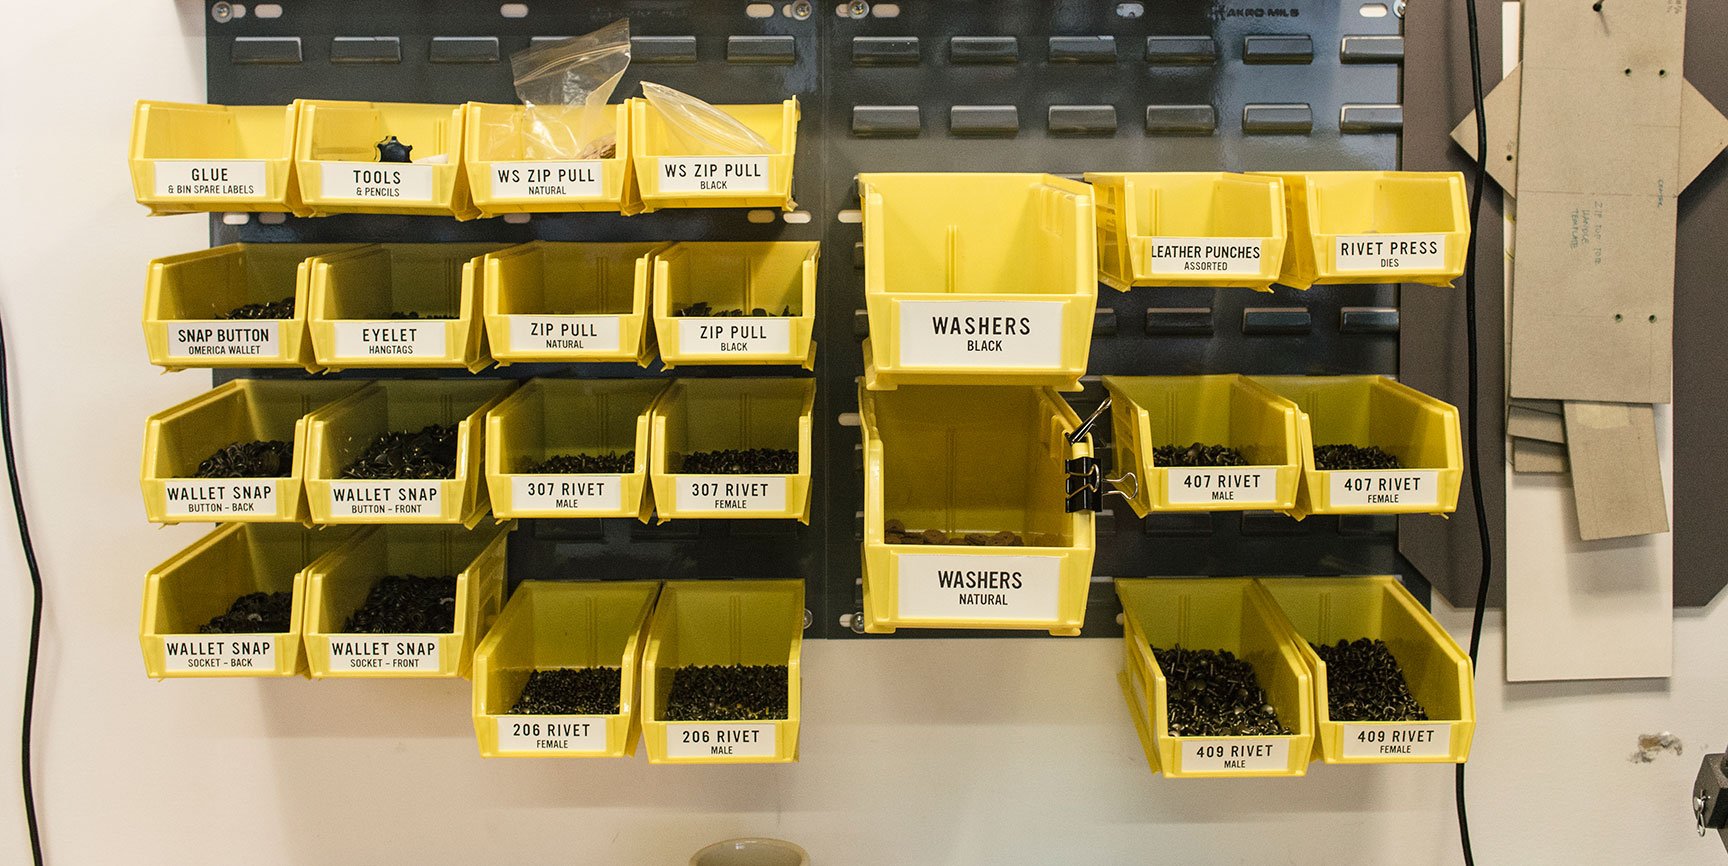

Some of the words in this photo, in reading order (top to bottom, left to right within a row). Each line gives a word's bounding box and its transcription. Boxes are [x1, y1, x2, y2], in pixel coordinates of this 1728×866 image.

[1227, 8, 1264, 17] AKRO
[191, 168, 228, 182] GLUE
[498, 170, 520, 183] WS
[528, 170, 551, 183] ZIP
[559, 169, 595, 182] PULL
[665, 164, 687, 177] WS
[694, 164, 718, 177] ZIP
[725, 164, 761, 177] PULL
[354, 170, 401, 185] TOOLS
[168, 186, 175, 194] &
[177, 185, 192, 194] BIN
[194, 185, 220, 194] SPARE
[223, 185, 254, 194] LABELS
[529, 186, 567, 195] NATURAL
[700, 181, 727, 190] BLACK
[356, 188, 363, 196] &
[365, 187, 400, 197] PENCILS
[1152, 245, 1201, 258] LEATHER
[1206, 246, 1260, 259] PUNCHES
[1341, 242, 1383, 256] RIVET
[1390, 241, 1438, 255] PRESS
[1184, 262, 1228, 271] ASSORTED
[1381, 258, 1399, 268] DIES
[531, 323, 554, 336] ZIP
[561, 323, 597, 337] PULL
[932, 317, 1030, 335] WASHERS
[178, 329, 213, 343] SNAP
[217, 329, 269, 342] BUTTON
[363, 329, 417, 342] EYELET
[700, 326, 723, 339] ZIP
[731, 325, 767, 339] PULL
[189, 346, 226, 355] OMERICA
[228, 345, 260, 354] WALLET
[369, 345, 413, 354] HANGTAGS
[546, 340, 584, 349] NATURAL
[721, 342, 748, 351] BLACK
[967, 340, 1002, 351] BLACK
[1184, 475, 1211, 488] 407
[1218, 474, 1261, 488] RIVET
[1344, 478, 1372, 491] 407
[1379, 478, 1421, 491] RIVET
[167, 486, 226, 500] WALLET
[233, 486, 272, 499] SNAP
[333, 488, 392, 502] WALLET
[398, 489, 438, 501] SNAP
[528, 483, 555, 496] 307
[561, 483, 605, 496] RIVET
[692, 483, 718, 497] 307
[725, 483, 768, 496] RIVET
[1212, 491, 1234, 500] MALE
[1368, 494, 1399, 504] FEMALE
[189, 503, 223, 512] BUTTON
[232, 502, 254, 512] BACK
[352, 505, 386, 514] BUTTON
[395, 504, 421, 514] FRONT
[556, 500, 578, 509] MALE
[715, 500, 747, 509] FEMALE
[938, 570, 1022, 589] WASHERS
[959, 594, 1008, 605] NATURAL
[167, 642, 225, 655] WALLET
[232, 642, 271, 655] SNAP
[332, 642, 390, 656] WALLET
[396, 642, 436, 655] SNAP
[188, 658, 221, 667] SOCKET
[230, 657, 253, 667] BACK
[350, 659, 384, 668] SOCKET
[393, 658, 420, 668] FRONT
[513, 724, 541, 737] 206
[547, 723, 590, 737] RIVET
[683, 730, 710, 743] 206
[717, 729, 760, 743] RIVET
[1358, 731, 1386, 743] 409
[1392, 730, 1435, 743] RIVET
[537, 740, 568, 749] FEMALE
[1380, 745, 1411, 754] FEMALE
[711, 746, 733, 755] MALE
[1196, 746, 1224, 758] 409
[1231, 745, 1273, 757] RIVET
[1224, 759, 1246, 768] MALE
